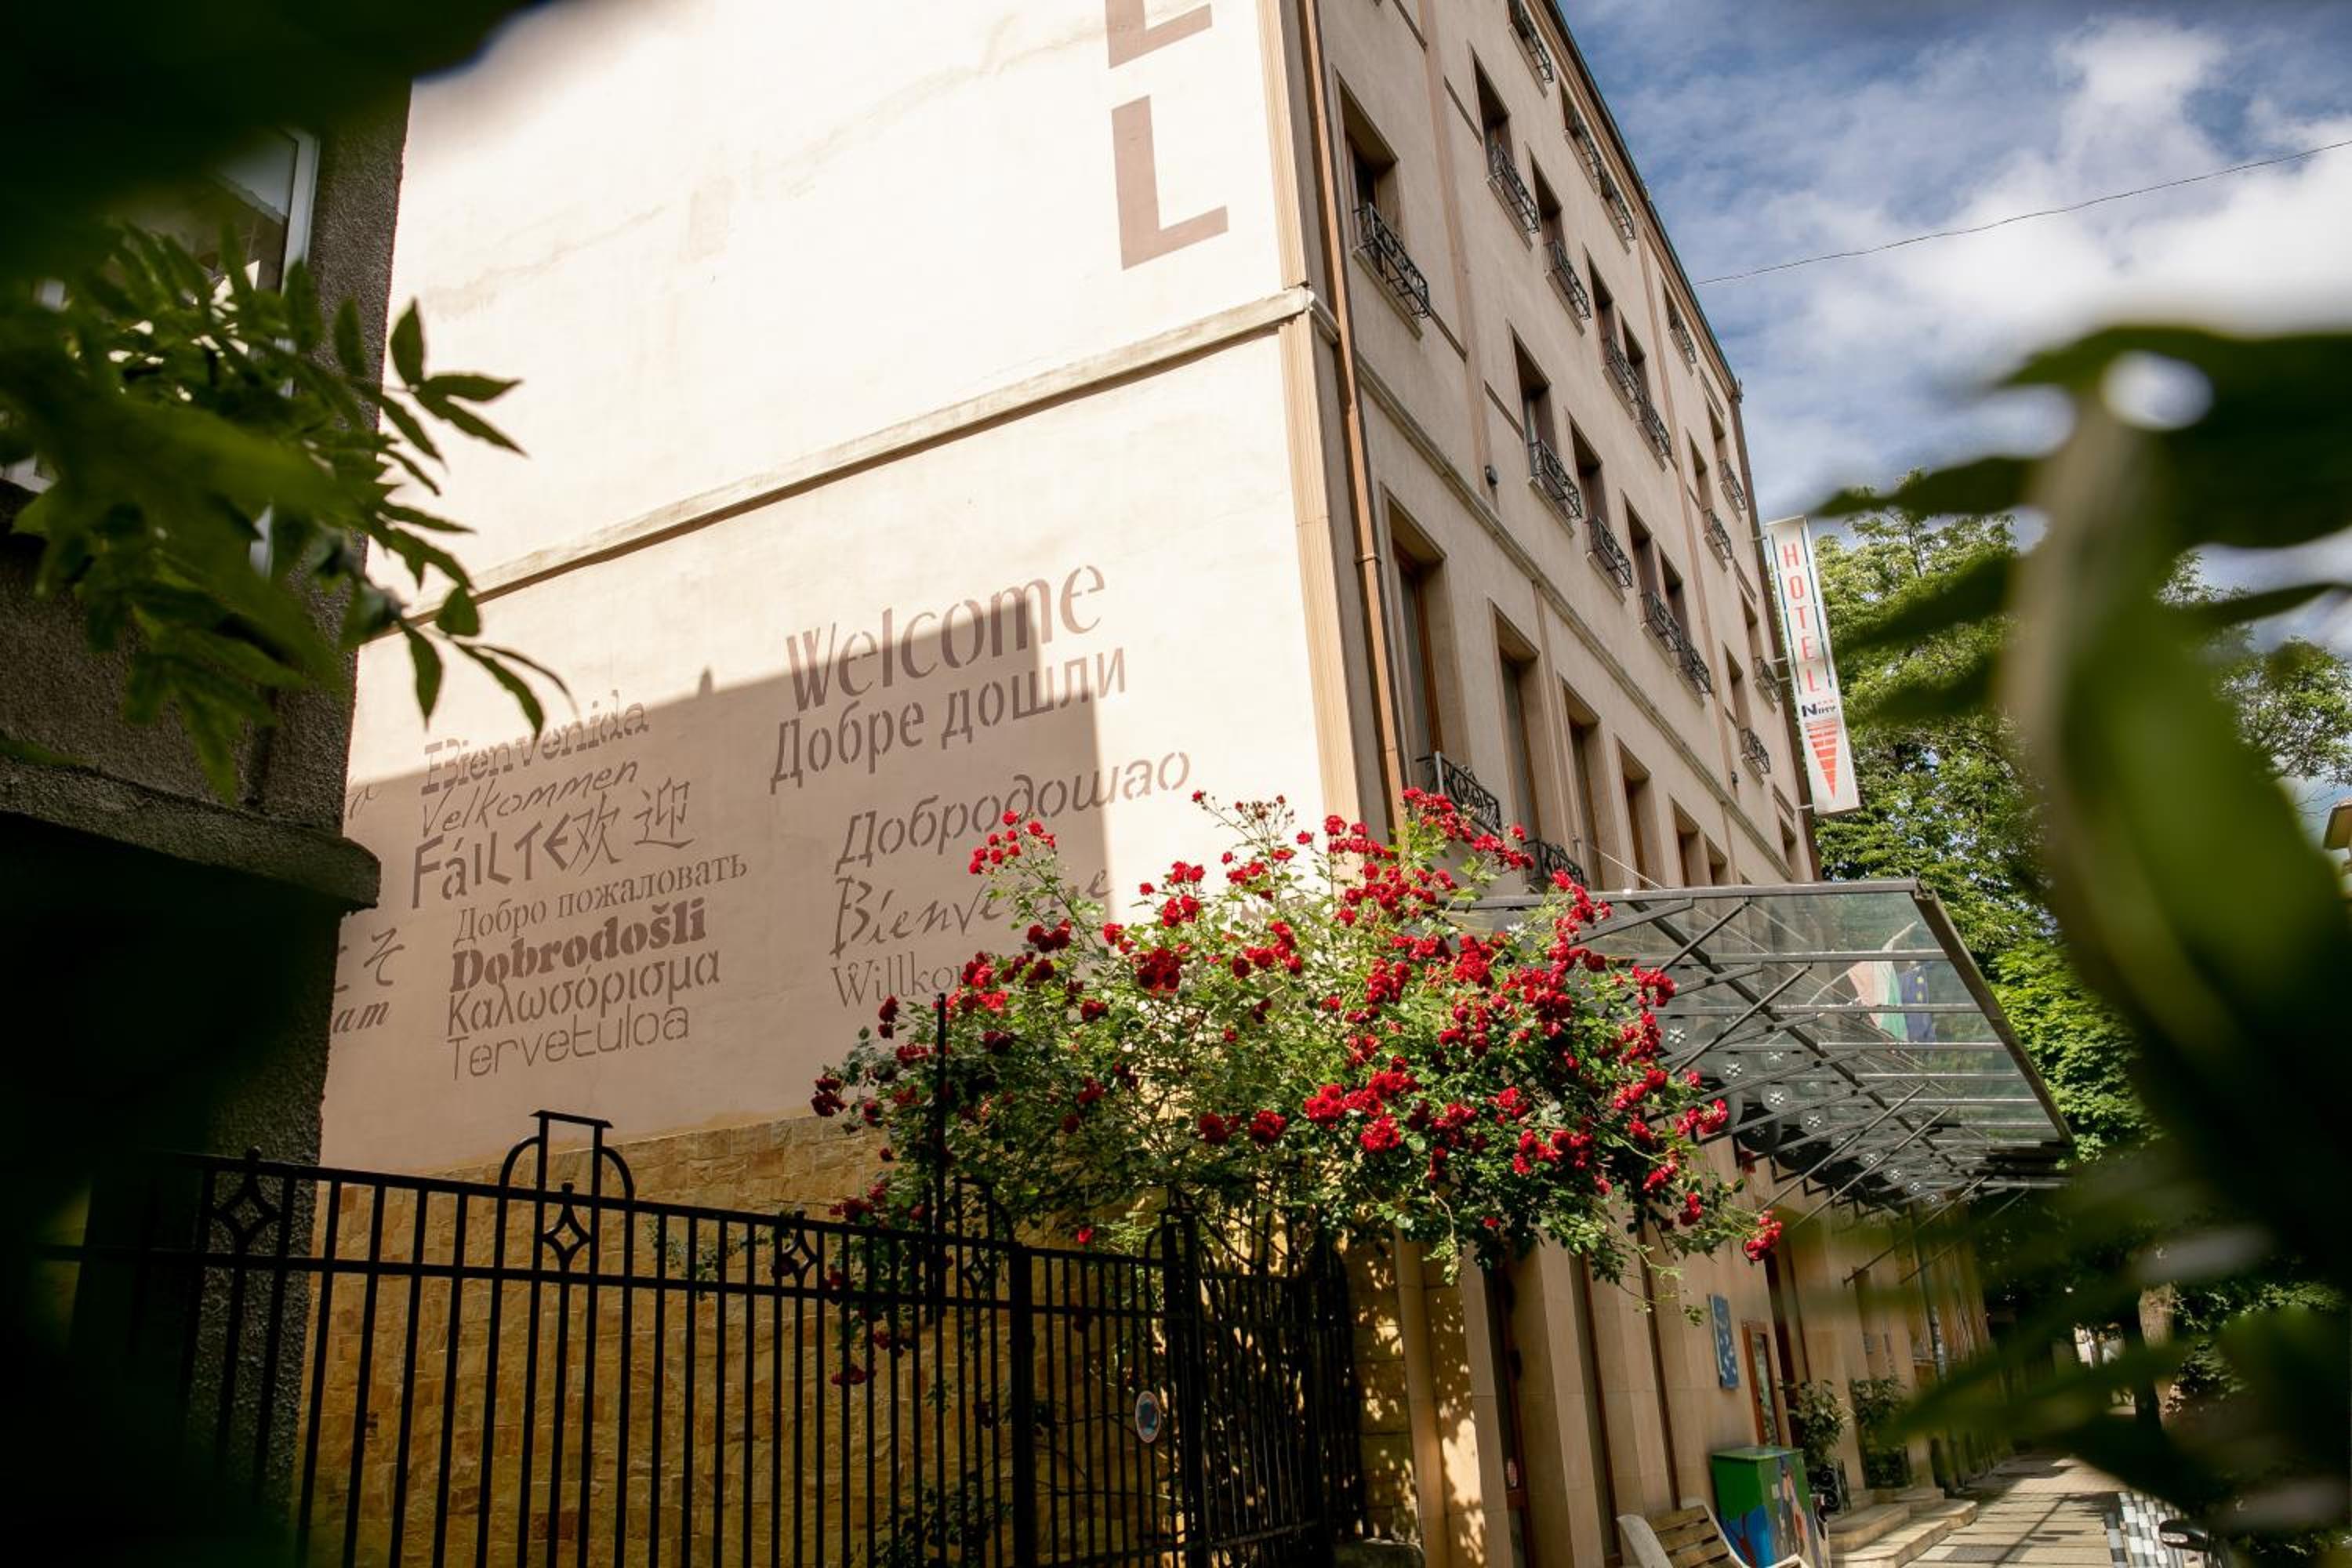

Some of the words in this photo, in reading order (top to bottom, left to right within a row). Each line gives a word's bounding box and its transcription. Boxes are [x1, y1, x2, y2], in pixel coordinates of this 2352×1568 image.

[785, 564, 1106, 712] Welcome
[1782, 542, 1821, 694] HOTEL
[421, 689, 650, 795] Bienvenida
[769, 699, 925, 795] Добре
[941, 646, 1126, 750] дошли
[423, 760, 639, 838] Velkommen
[568, 777, 695, 877] 欢迎
[834, 752, 1191, 875] Добродошао
[449, 897, 706, 993] Dobrodošli
[452, 898, 547, 949] Добро
[557, 854, 748, 919] пожаловать
[447, 950, 720, 1036] Καλωσόρισμα
[447, 1004, 689, 1080] Tervetuloa
